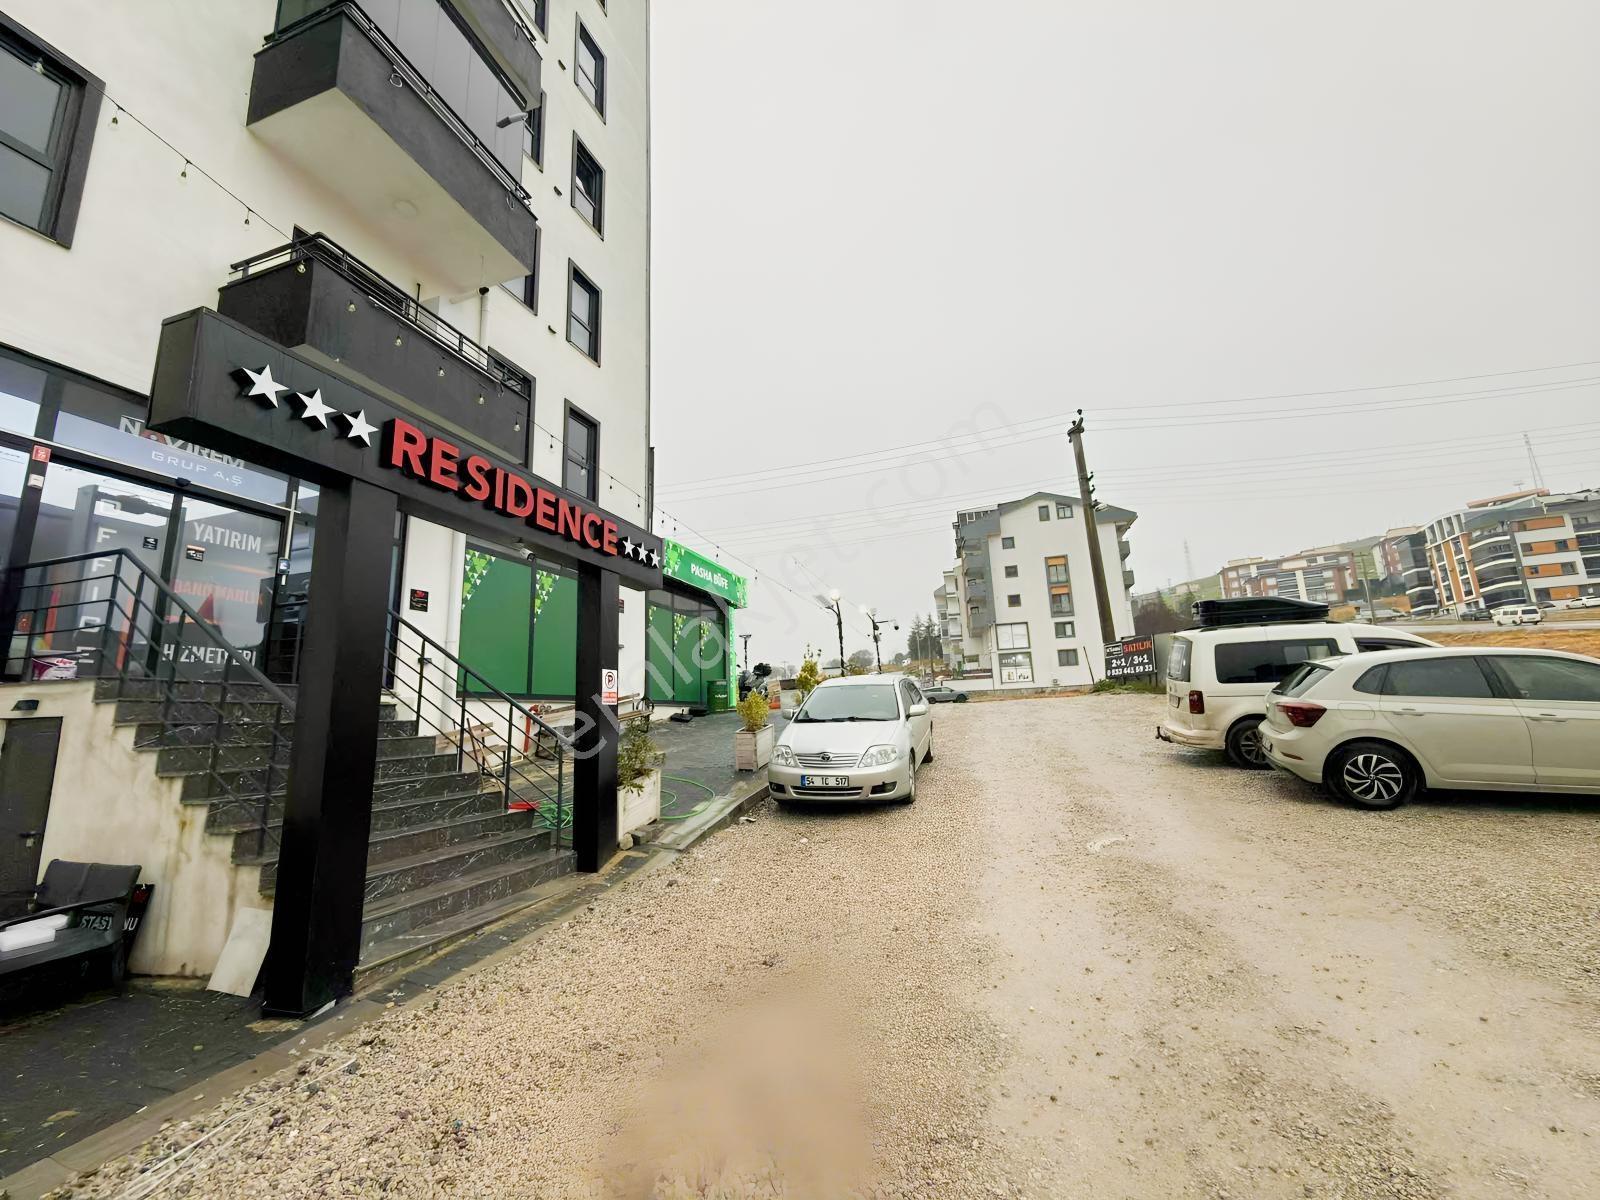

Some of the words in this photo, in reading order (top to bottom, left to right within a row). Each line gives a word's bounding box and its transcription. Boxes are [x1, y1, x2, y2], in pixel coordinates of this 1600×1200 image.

[151, 450, 208, 474] GRUP
[390, 417, 619, 557] RESIDENCE
[193, 521, 262, 554] YATIRIM
[691, 563, 713, 582] PASHA
[1111, 657, 1126, 668] 2+1
[1133, 653, 1149, 664] 3+1
[806, 776, 815, 785] 54
[835, 777, 847, 786] 517
